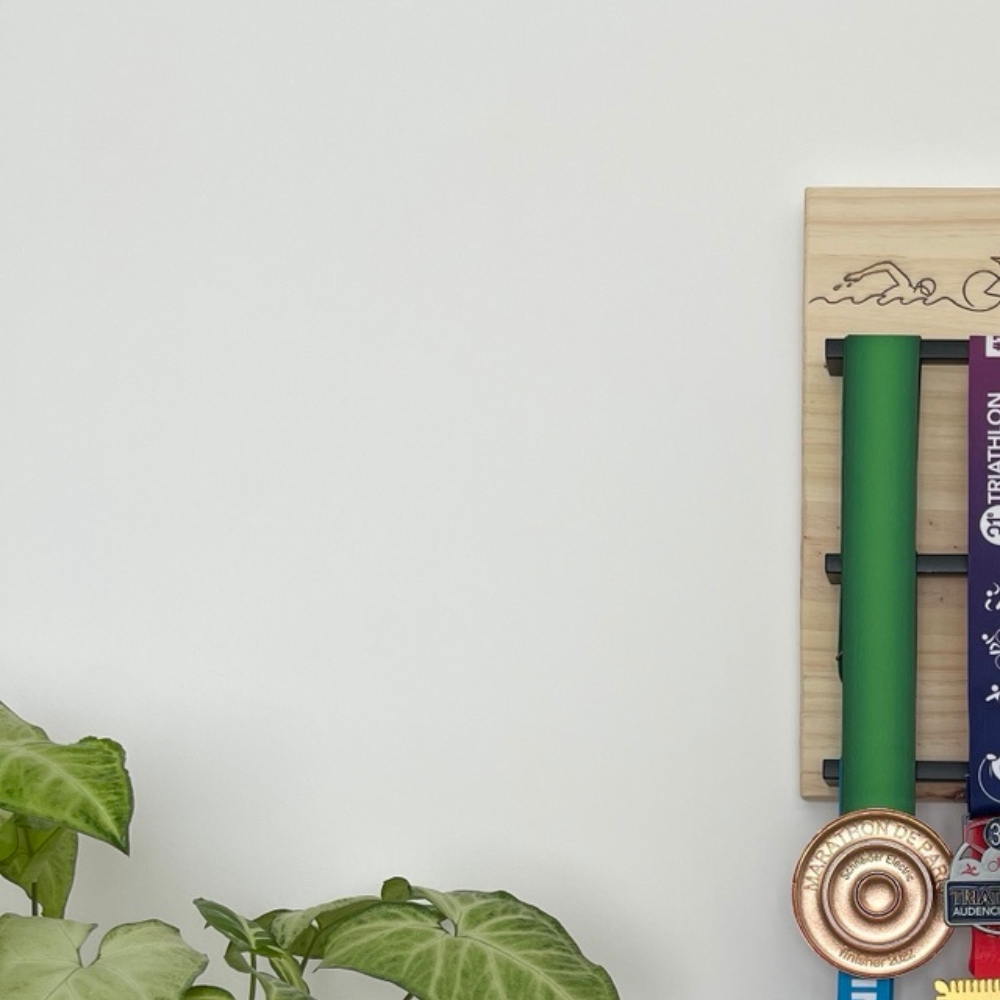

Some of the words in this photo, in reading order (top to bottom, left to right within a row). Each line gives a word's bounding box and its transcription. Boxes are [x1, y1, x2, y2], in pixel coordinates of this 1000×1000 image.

[803, 820, 888, 891] MARATHON
[894, 823, 920, 846] DE
[919, 838, 949, 884] PAR
[885, 854, 914, 882] Electric
